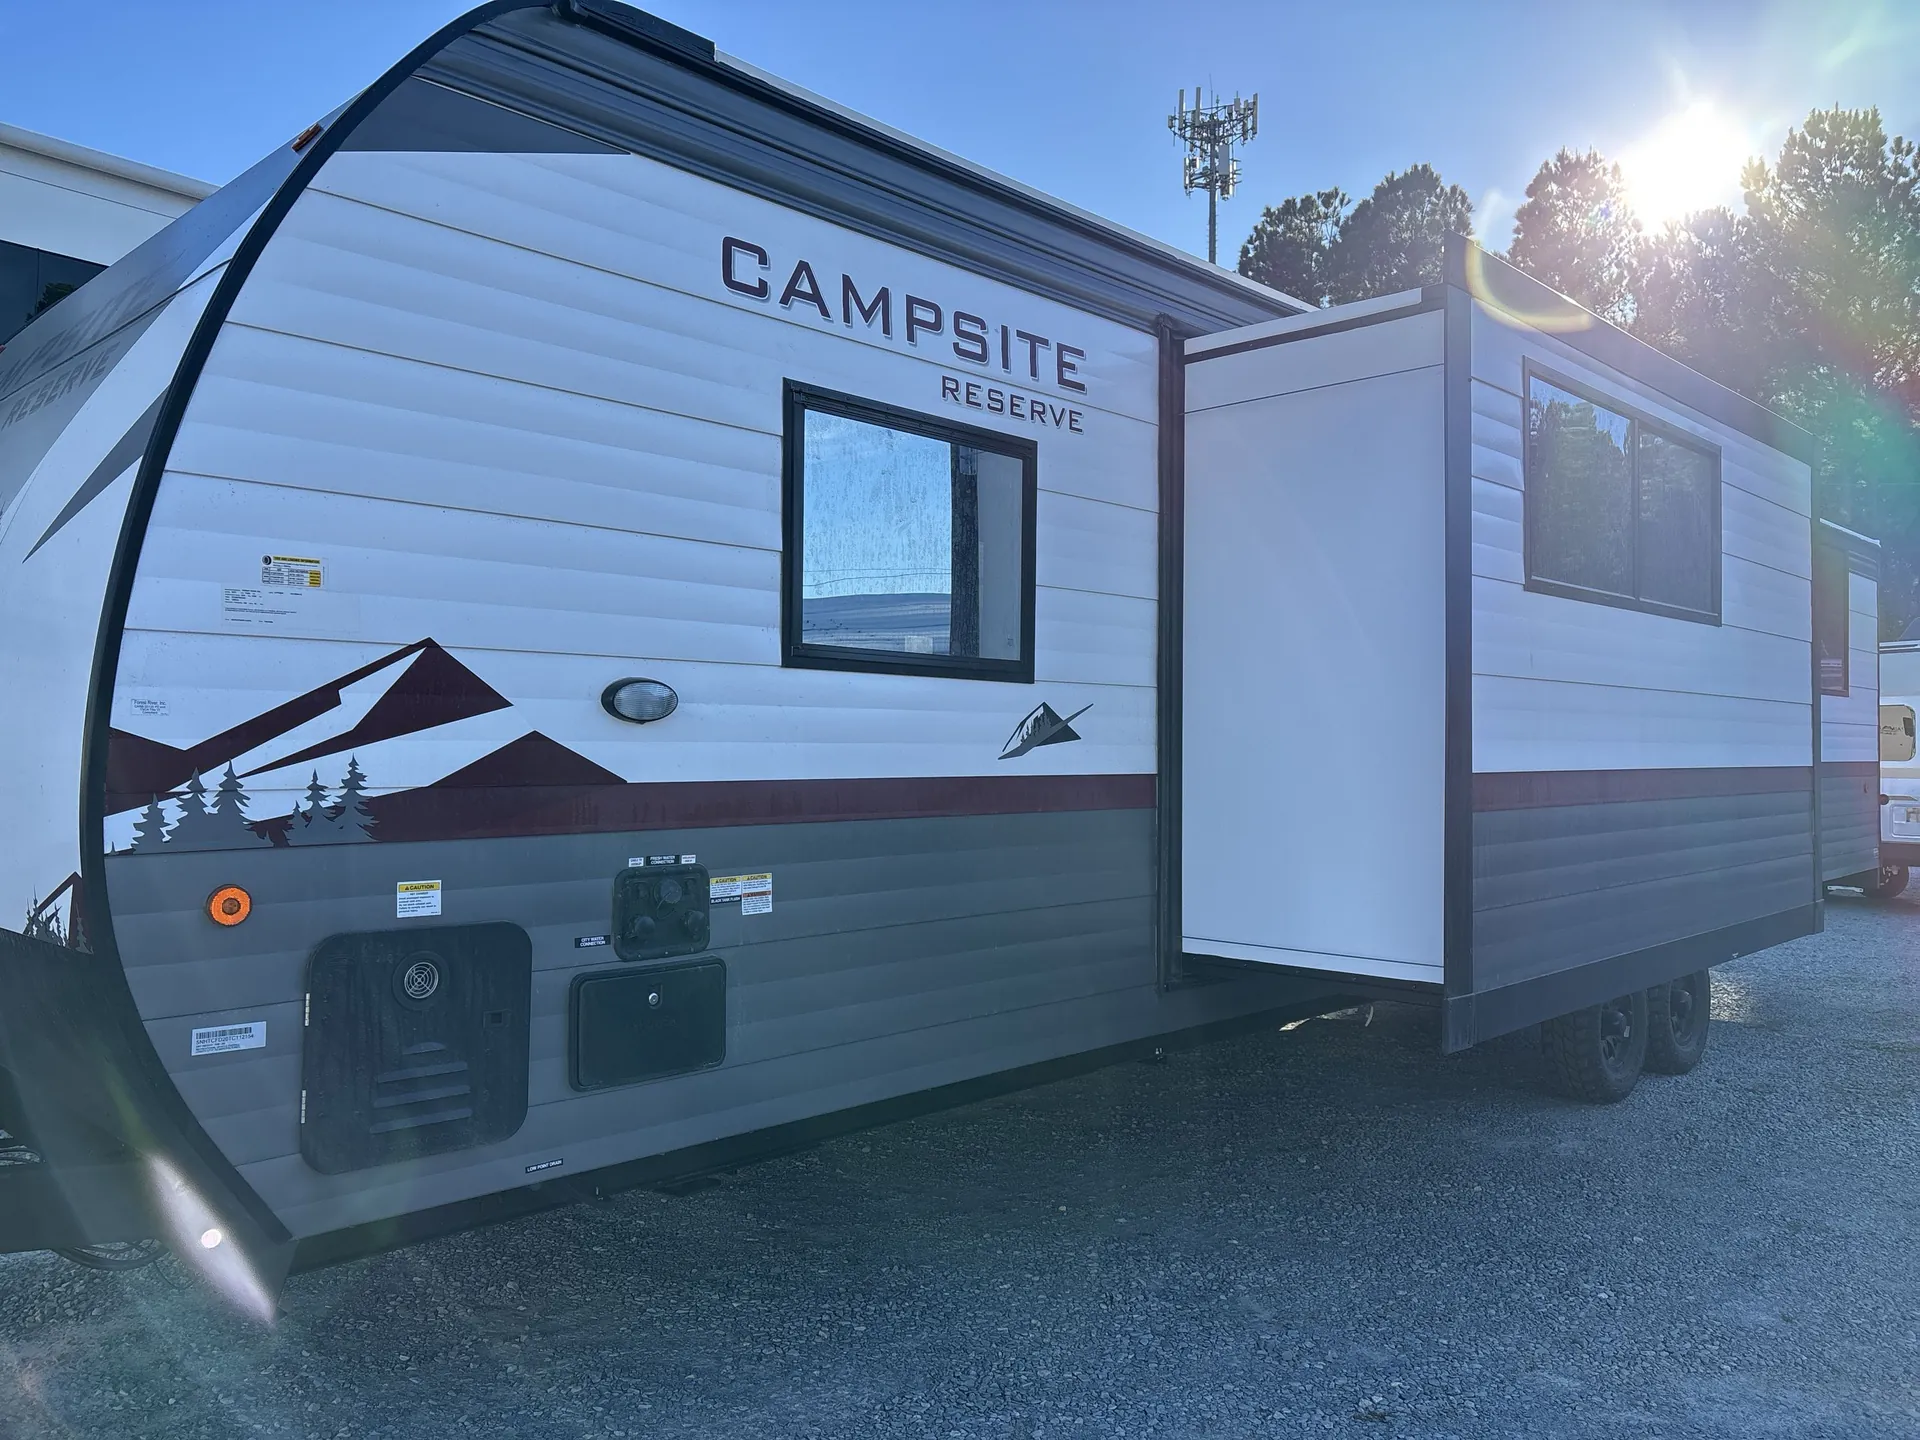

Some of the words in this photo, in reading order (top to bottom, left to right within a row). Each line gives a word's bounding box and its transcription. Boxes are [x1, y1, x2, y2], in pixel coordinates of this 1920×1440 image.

[721, 236, 1087, 394] CAMPSITE
[2, 341, 121, 431] RESERVE
[941, 375, 1084, 434] RESERVE
